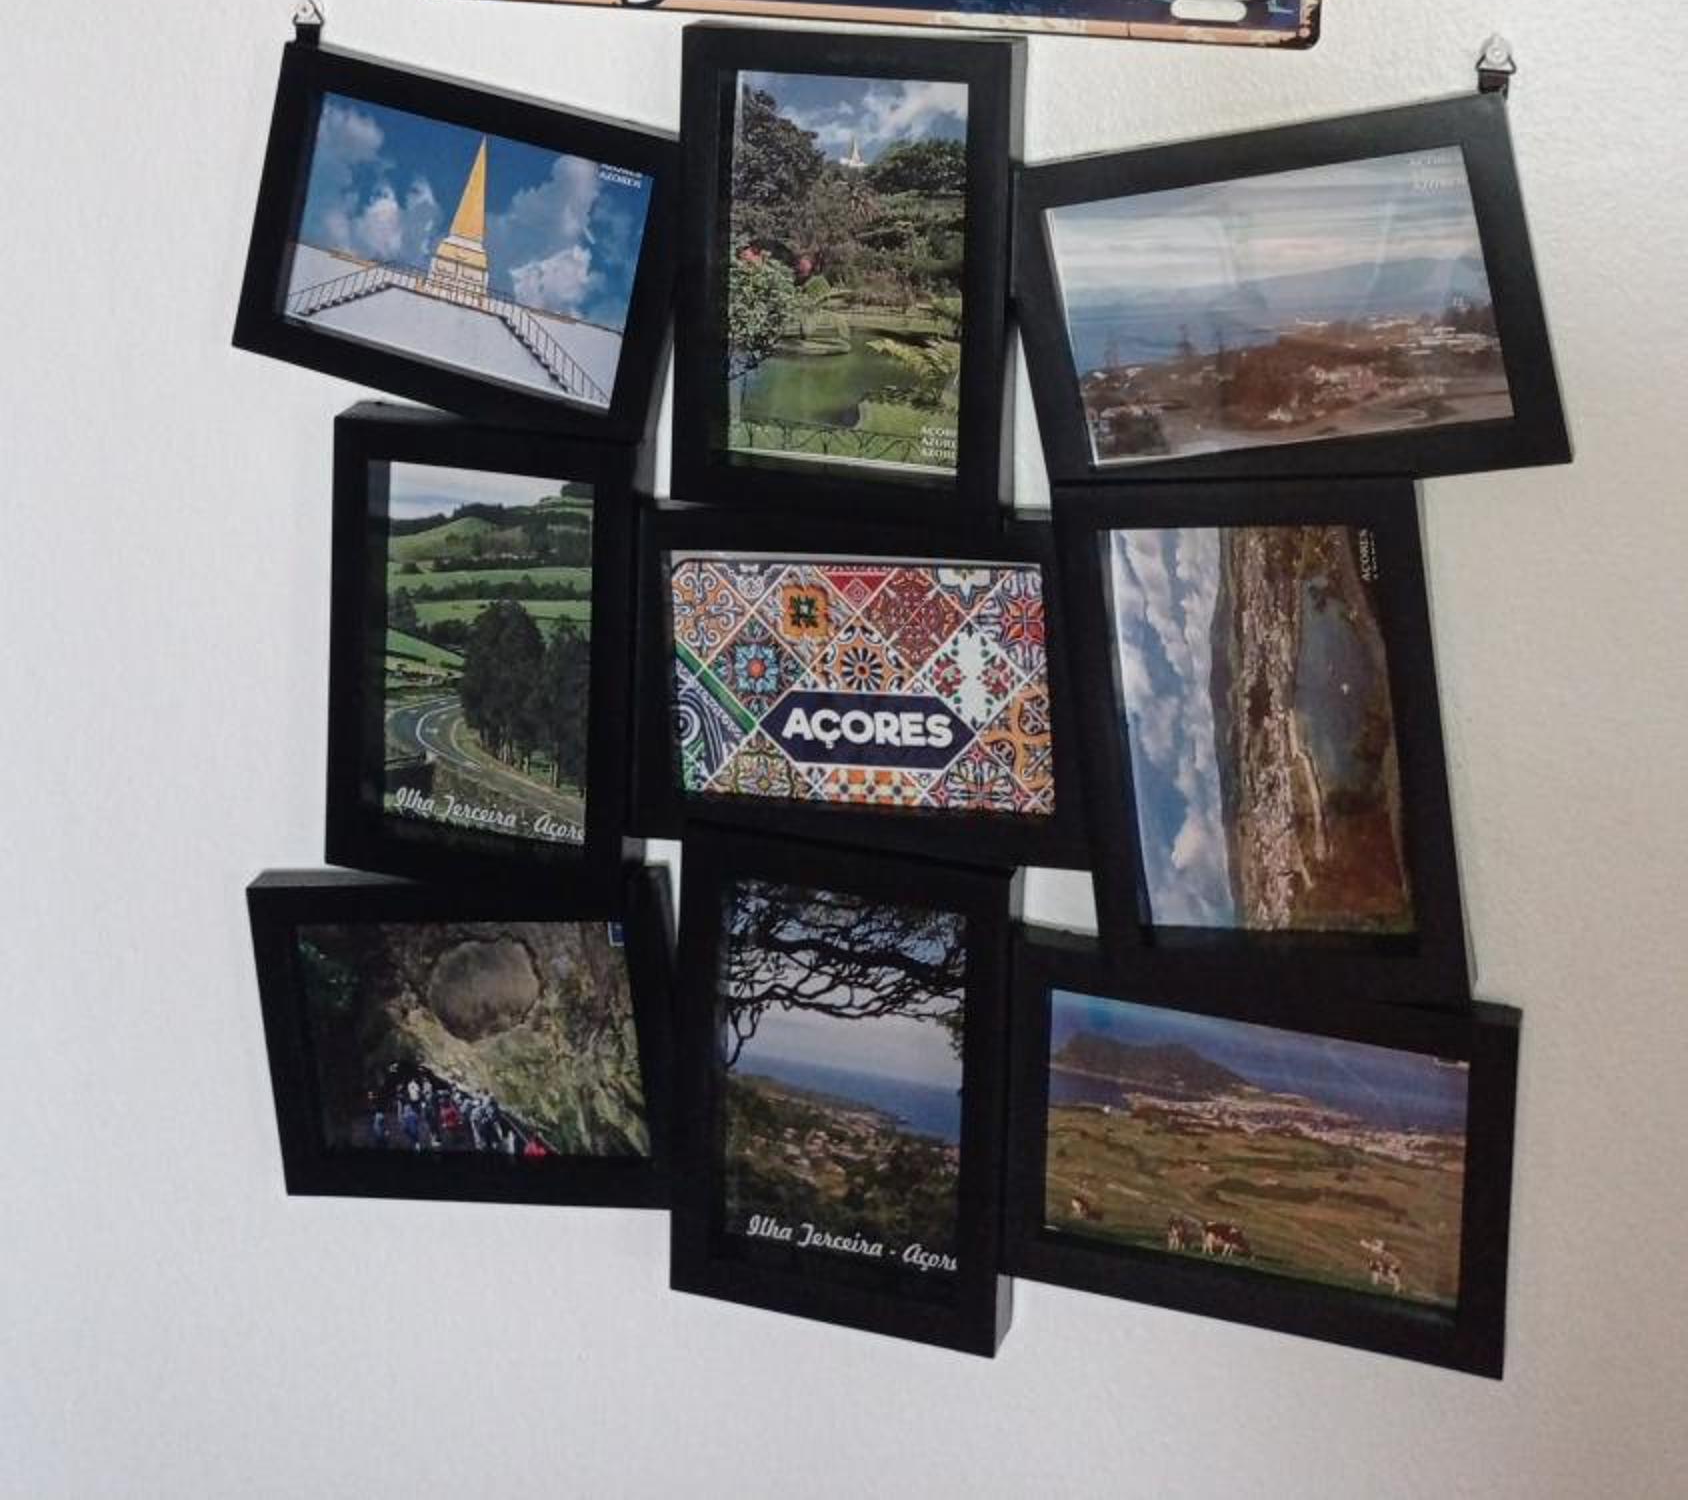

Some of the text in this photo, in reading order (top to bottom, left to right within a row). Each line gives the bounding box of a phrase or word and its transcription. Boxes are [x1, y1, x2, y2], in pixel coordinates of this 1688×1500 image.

[781, 706, 954, 750] AÇORES
[395, 786, 435, 812] Ilha
[442, 794, 518, 827] Terceira
[746, 1214, 793, 1241] Ilha
[797, 1222, 884, 1258] Terceira
